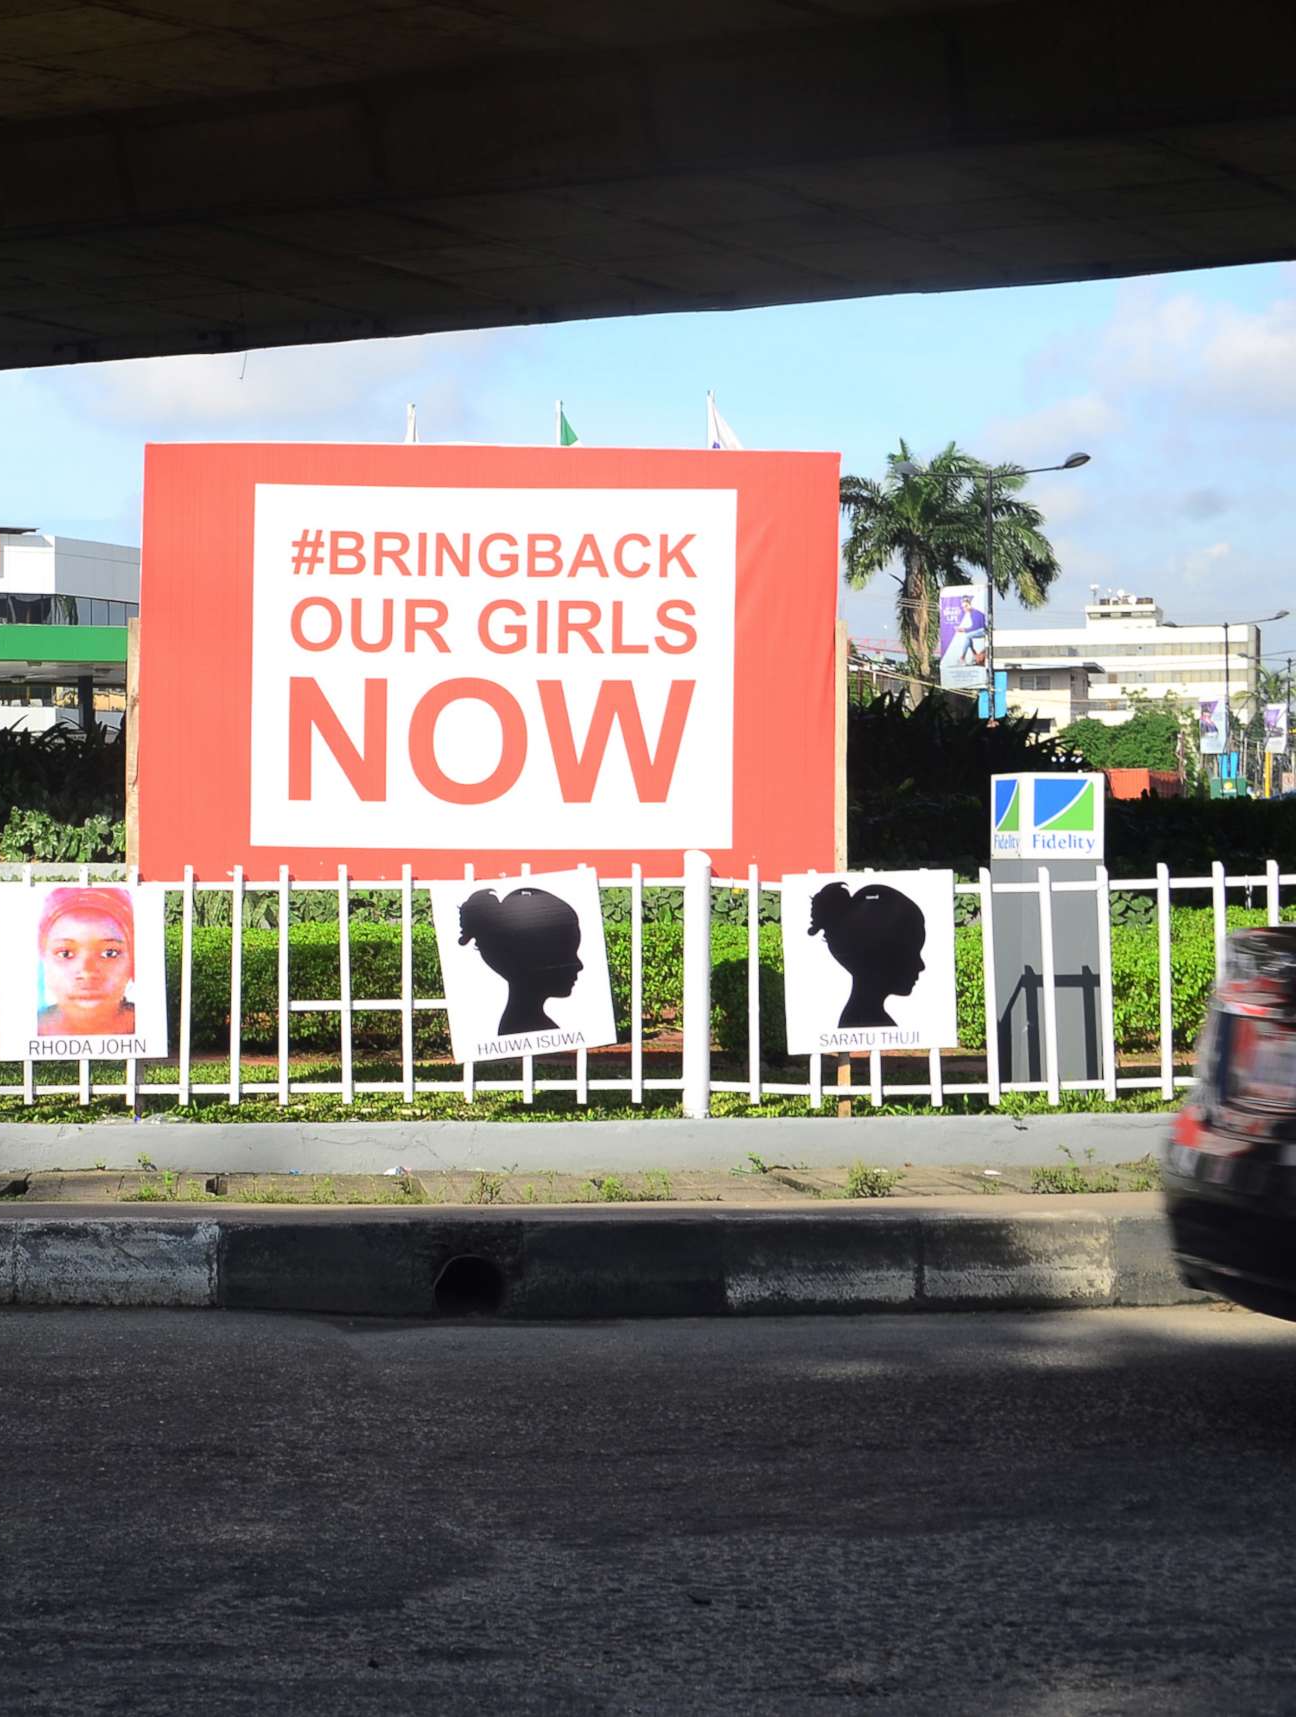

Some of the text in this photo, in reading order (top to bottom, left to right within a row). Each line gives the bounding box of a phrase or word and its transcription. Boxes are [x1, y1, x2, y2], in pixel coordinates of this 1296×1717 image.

[291, 529, 698, 578] #BRINGBACK
[290, 596, 698, 655] OUR GIRLS
[288, 676, 697, 805] NOW
[1033, 834, 1095, 854] Fidelity
[28, 1038, 147, 1055] RHODA JOHN
[477, 1031, 586, 1056] HAUWA ISUWA
[819, 1031, 920, 1047] SARATU THUJI
